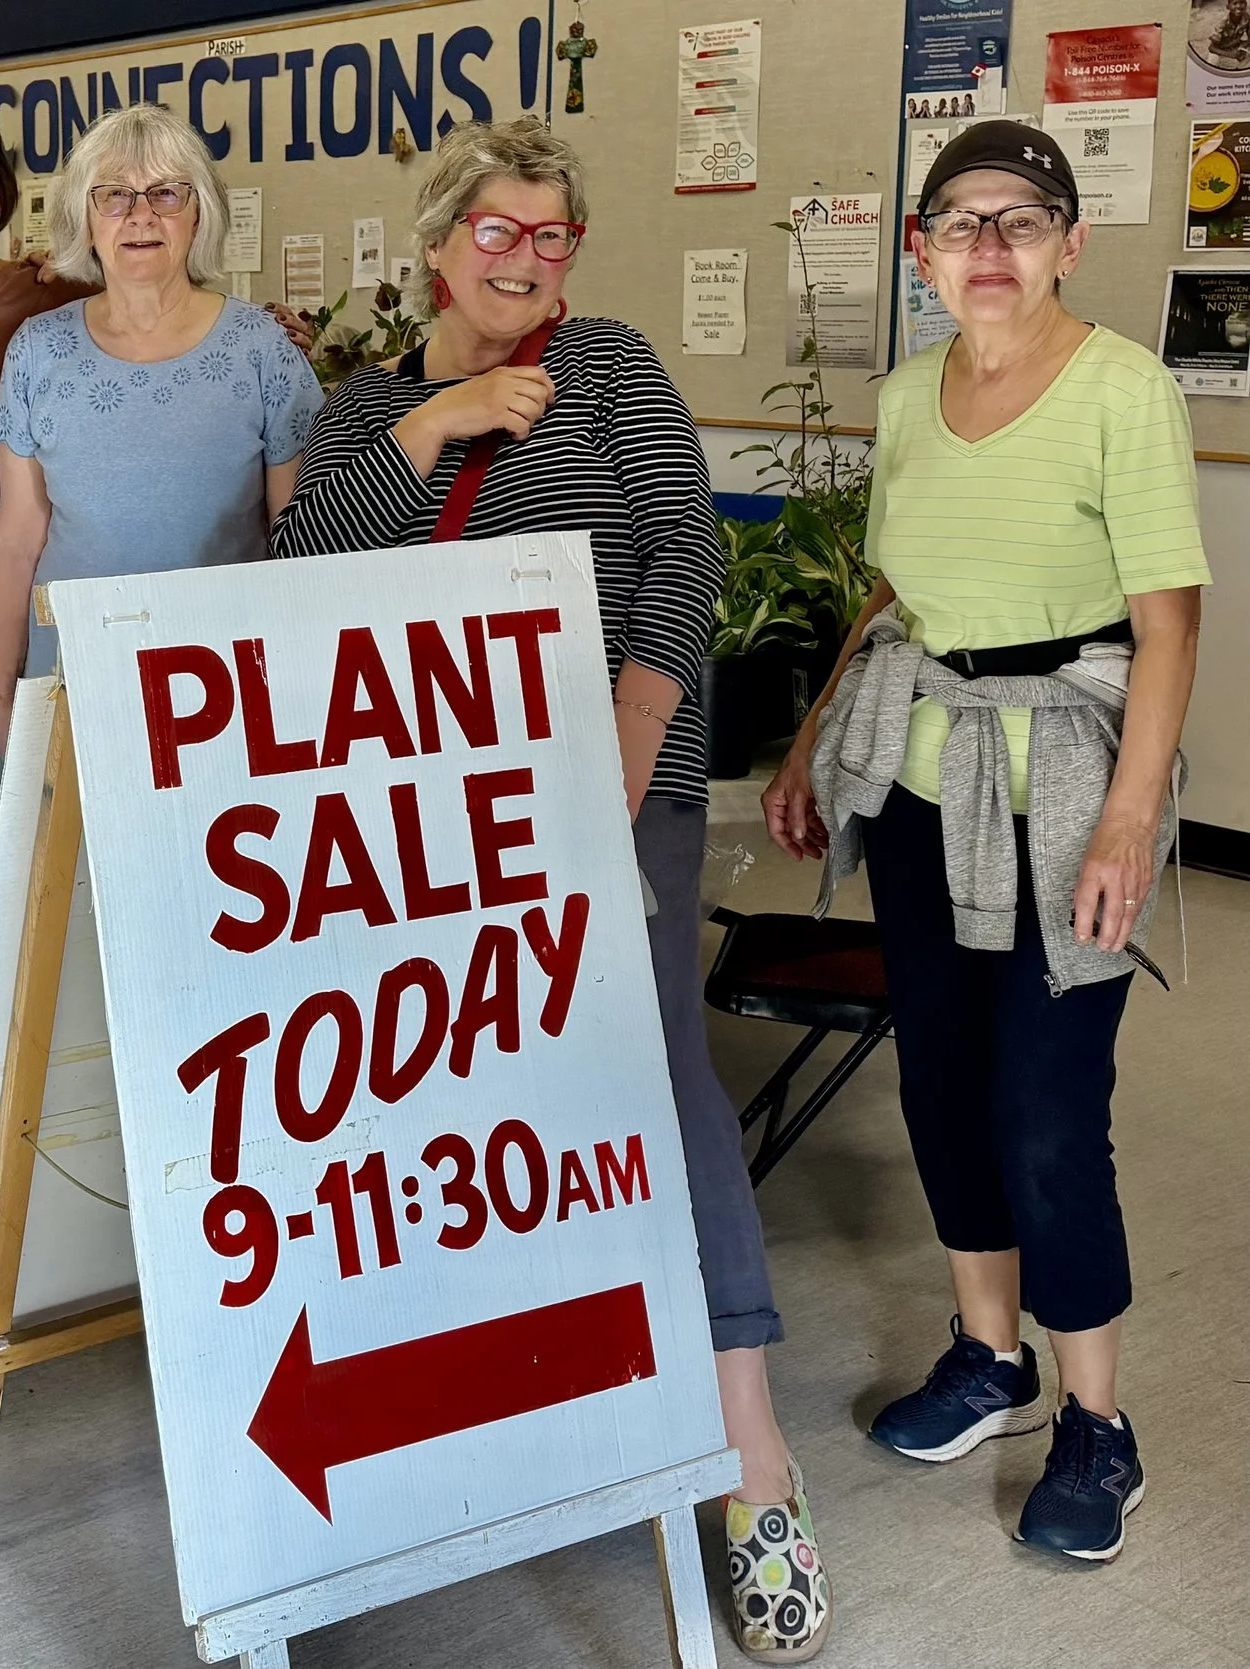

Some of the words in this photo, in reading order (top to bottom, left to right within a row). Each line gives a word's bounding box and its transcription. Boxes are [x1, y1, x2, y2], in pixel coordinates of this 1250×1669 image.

[208, 39, 244, 56] PARISH
[1064, 67, 1090, 77] 1-844
[1092, 63, 1140, 75] POISON-X
[1238, 136, 1250, 144] CO
[831, 200, 860, 211] SAFE
[830, 213, 879, 225] CHURCH
[691, 274, 711, 283] Come
[713, 274, 719, 283] &
[1206, 301, 1248, 312] NONE
[704, 329, 720, 339] Sale
[136, 607, 562, 790] PLANT
[204, 767, 550, 954] SALE
[177, 892, 591, 1184] TODAY
